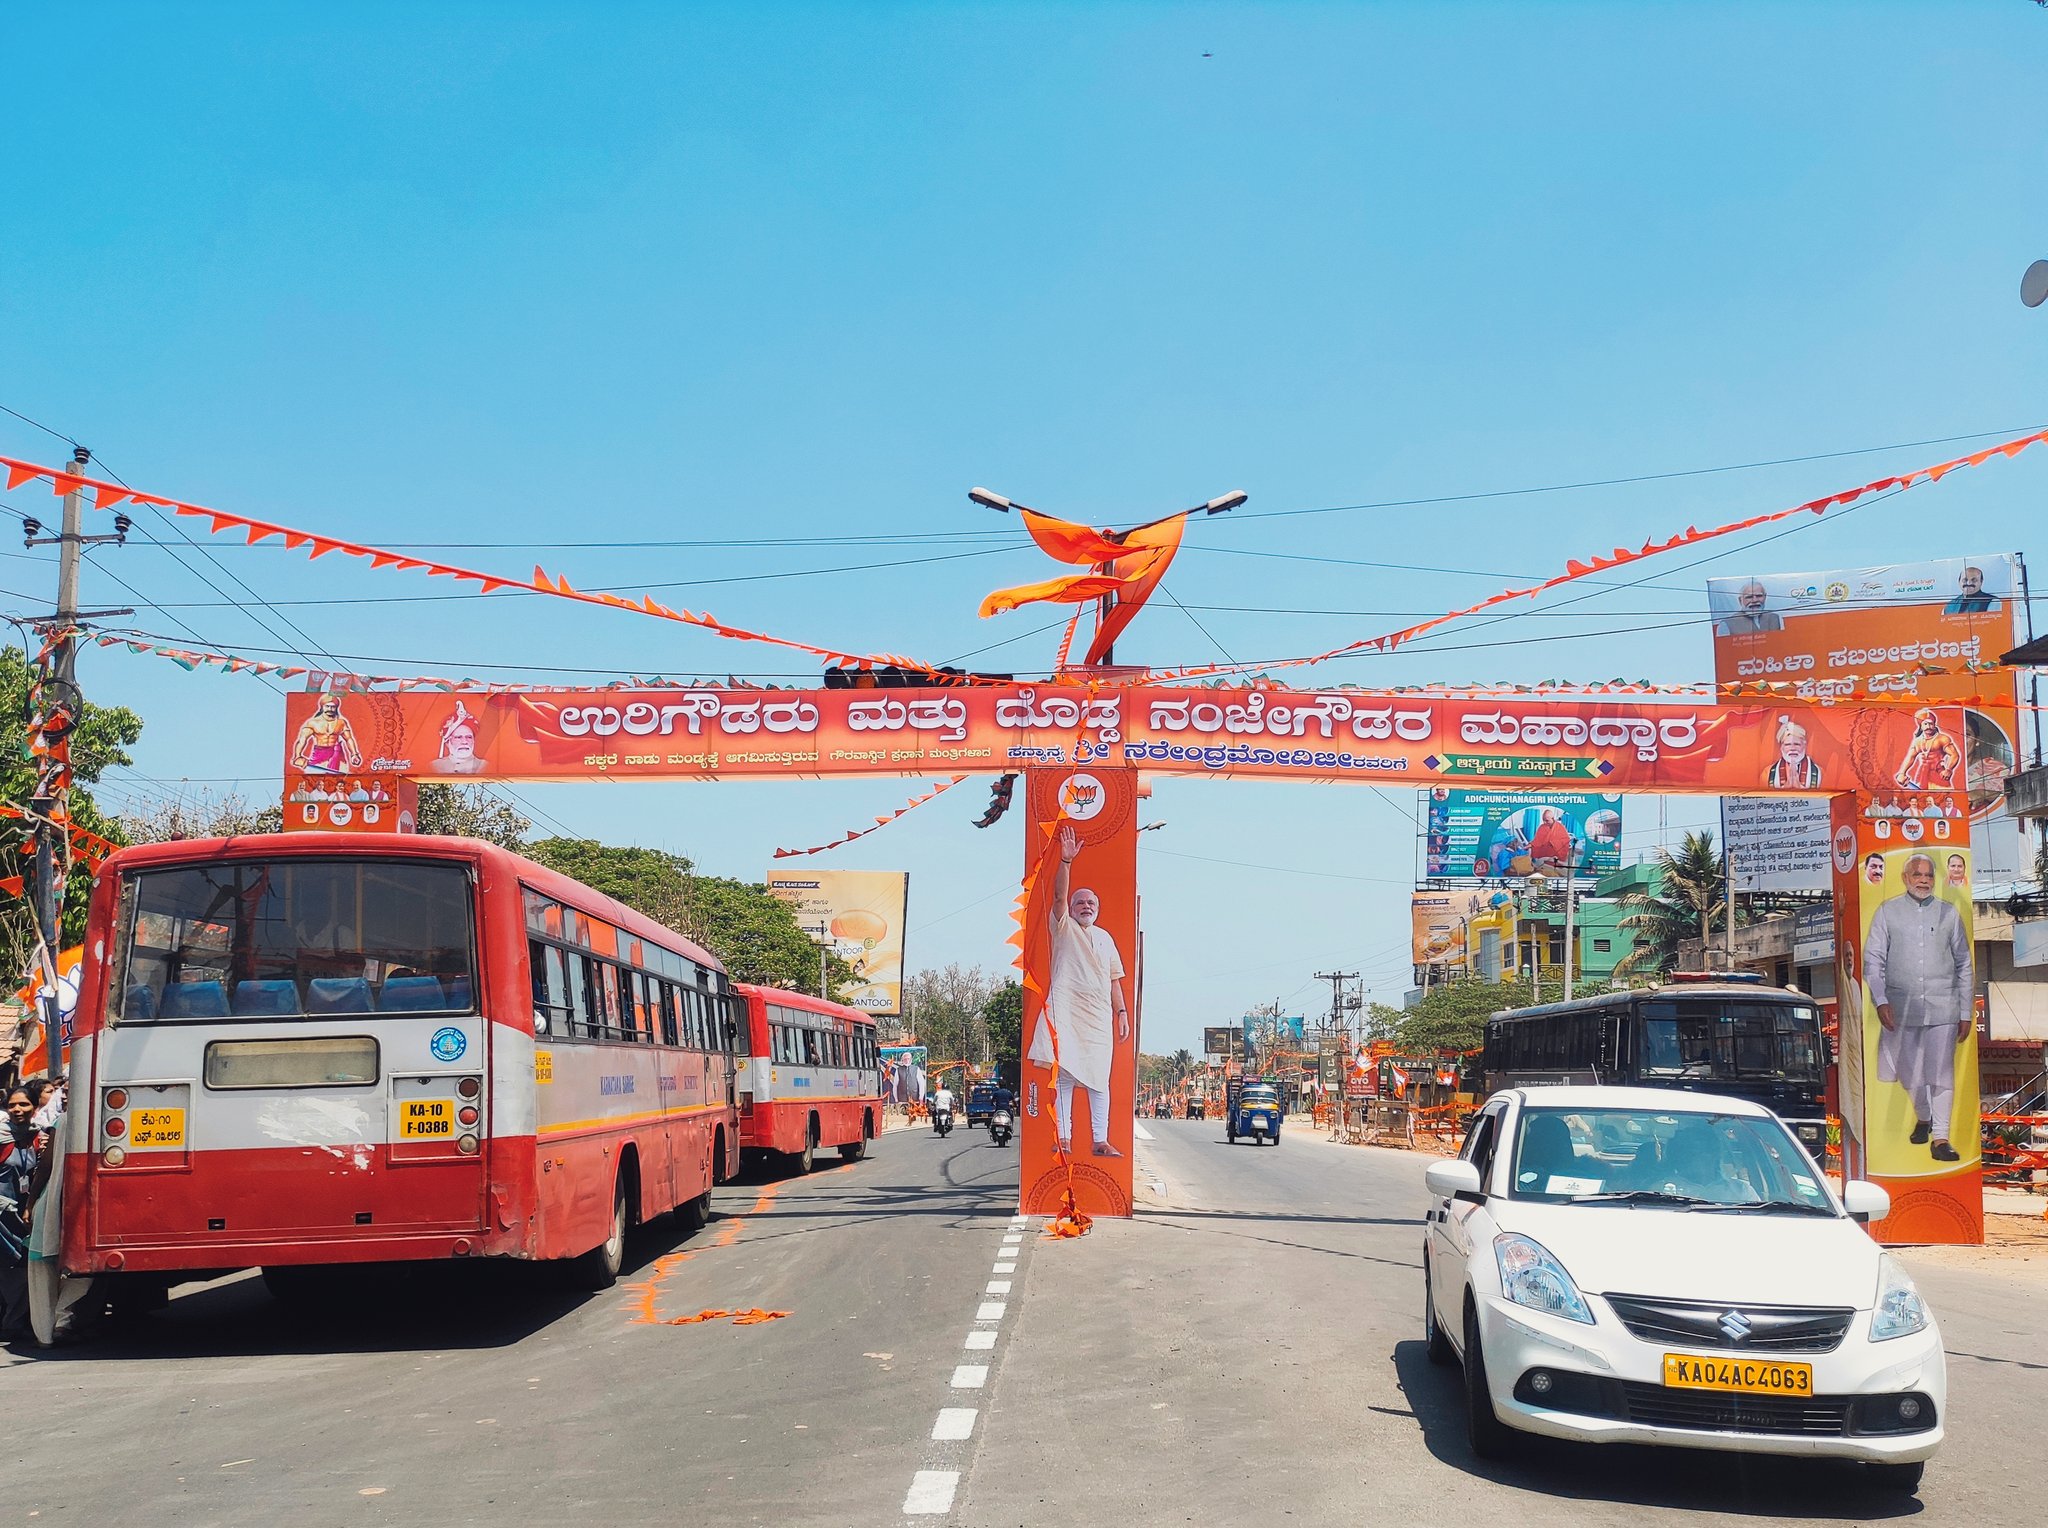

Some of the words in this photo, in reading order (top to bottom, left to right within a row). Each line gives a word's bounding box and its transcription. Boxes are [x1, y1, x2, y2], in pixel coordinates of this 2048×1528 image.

[1737, 654, 1815, 676] ಮಹಿಳಾ
[1828, 635, 1982, 669] ಸಬಲೀಕರಣಕ್ಕೆ
[559, 693, 820, 737] ಉರಿಗೌಡರು
[847, 695, 967, 742] ಮತ್ತು
[996, 686, 1122, 743] ದೊಡ್ಡ
[1149, 692, 1433, 741] ನಂಜೇಗೌಡರ
[1460, 708, 1698, 762] ಮಹಾದ್ವಾರ
[584, 754, 618, 770] ಸಕ್ಕರೆ
[624, 755, 660, 766] ನಾಡು
[667, 752, 719, 769] ಮಂಡ್ಯಕ್ಕೆ
[725, 750, 819, 765] ಆಗಮಿಸುತ್ತಿರುವ
[830, 749, 886, 764] ಗೌರವಾನ್ವಿತ
[891, 749, 924, 762] ಪ್ರಧಾನ
[929, 746, 991, 760] ಮಂತ್ರಿಗಳಾದ
[1072, 739, 1111, 765] ಶ್ರೀ
[1456, 757, 1511, 775] ಆತ್ಮೀಯ
[1518, 758, 1576, 777] ಸುಸ್ವಾಗತ
[1464, 795, 1546, 804] ADICHUNCHANAGIRI
[1547, 795, 1588, 804] HOSPITAL
[832, 946, 863, 956] ANTOOR
[409, 1103, 443, 1117] KA-10
[407, 1120, 449, 1135] F-0388
[1678, 1360, 1808, 1390] KA04AC4063
